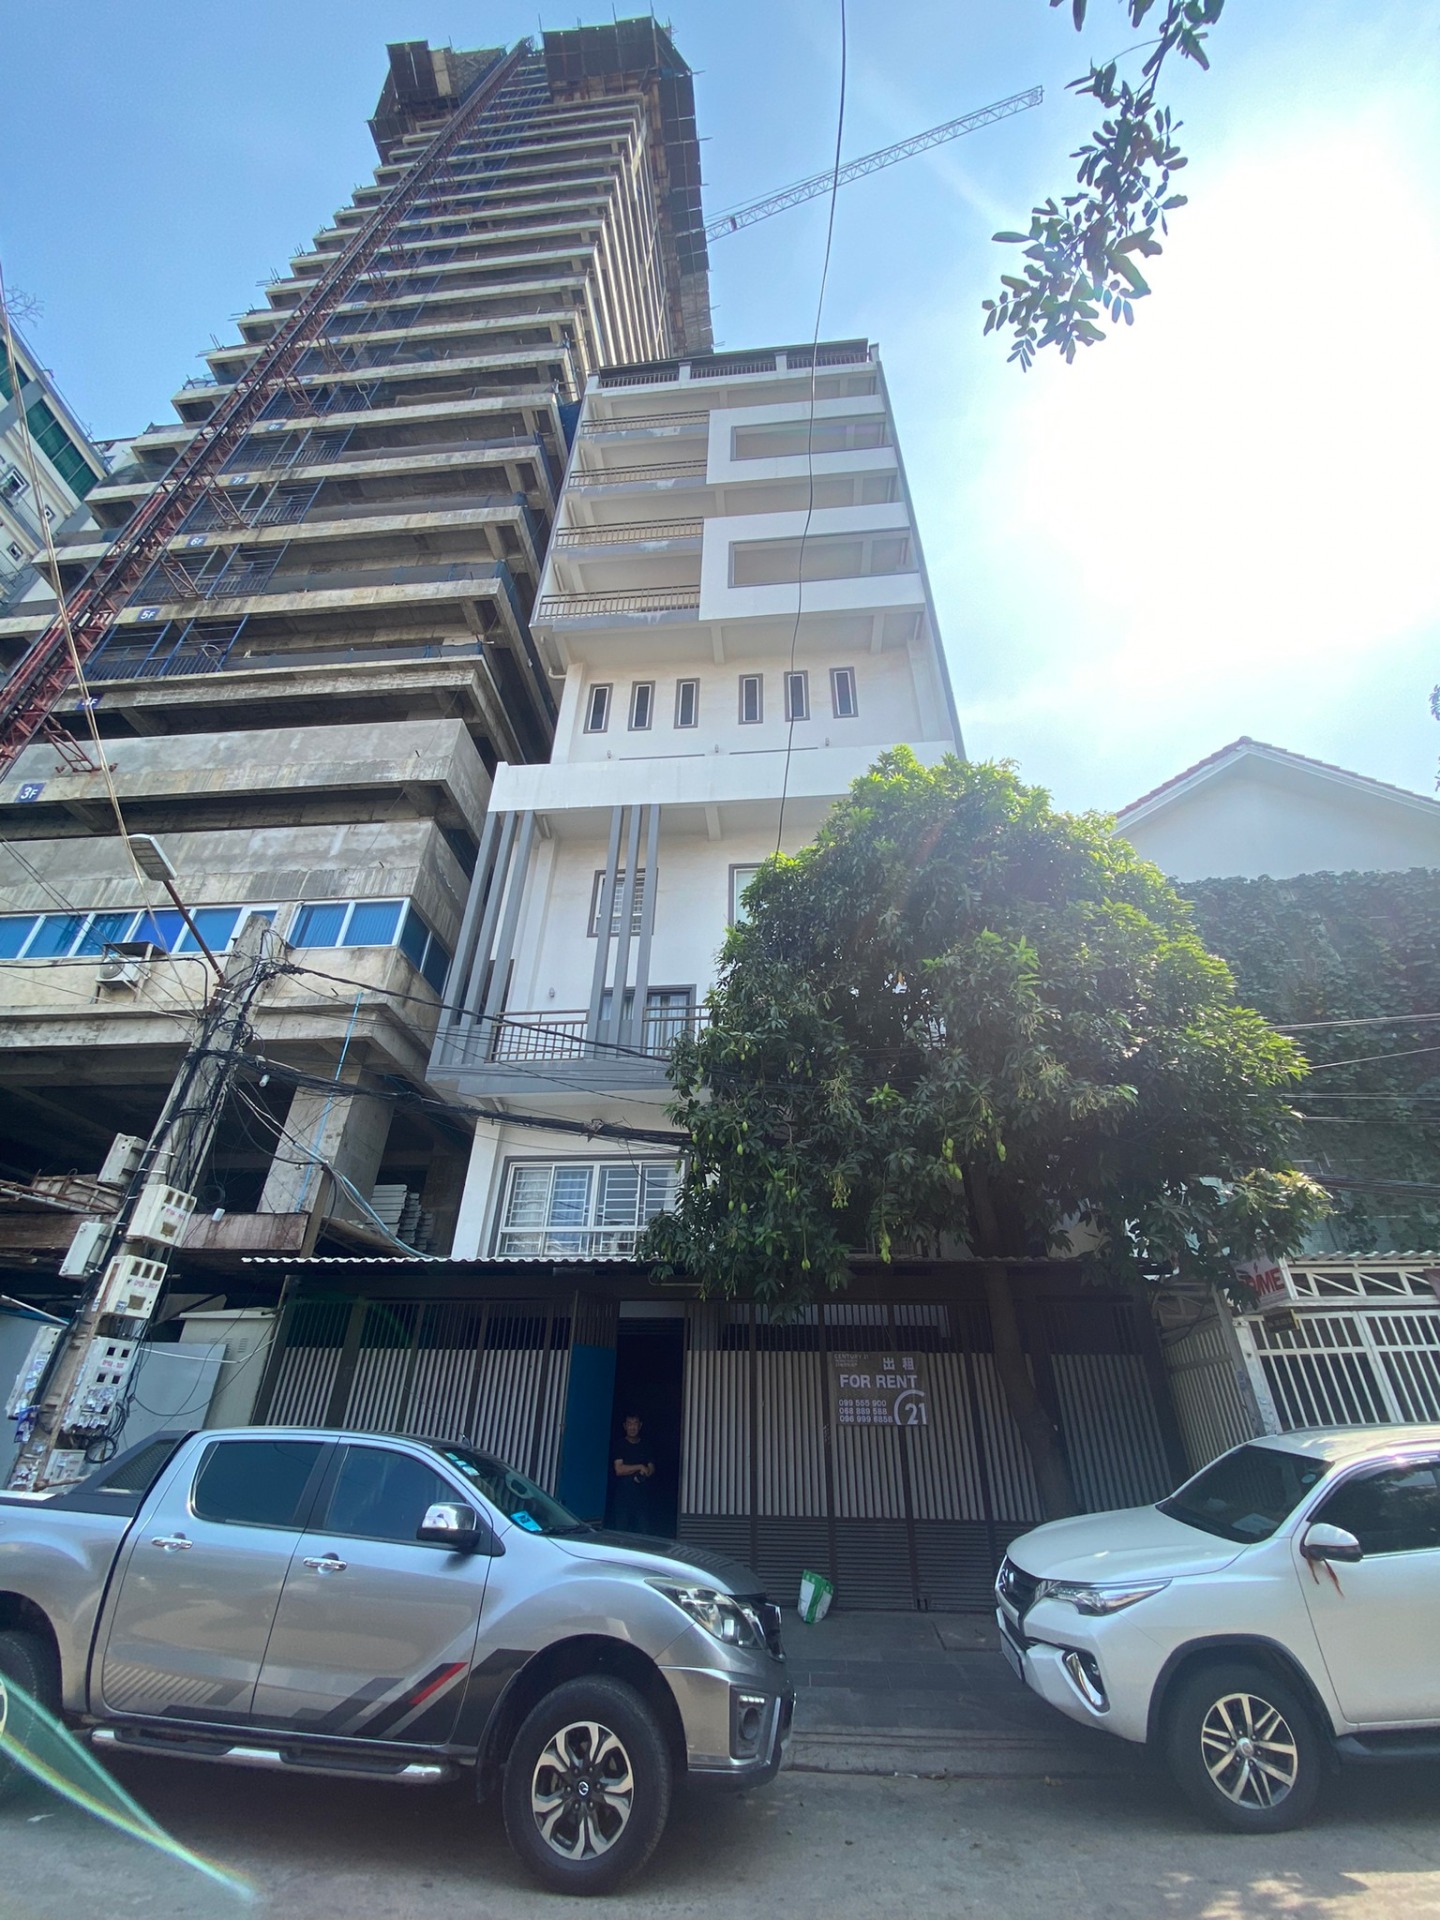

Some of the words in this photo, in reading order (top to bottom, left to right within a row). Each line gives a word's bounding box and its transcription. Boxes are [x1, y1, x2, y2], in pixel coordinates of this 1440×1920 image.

[232, 476, 245, 484] 7F
[190, 537, 204, 546] 6F
[140, 610, 156, 620] 5F
[20, 787, 39, 799] 3F
[882, 1356, 915, 1371] 出租
[840, 1374, 871, 1388] FOR
[876, 1374, 917, 1389] RENT
[855, 1399, 870, 1407] 555
[872, 1399, 887, 1407] 900
